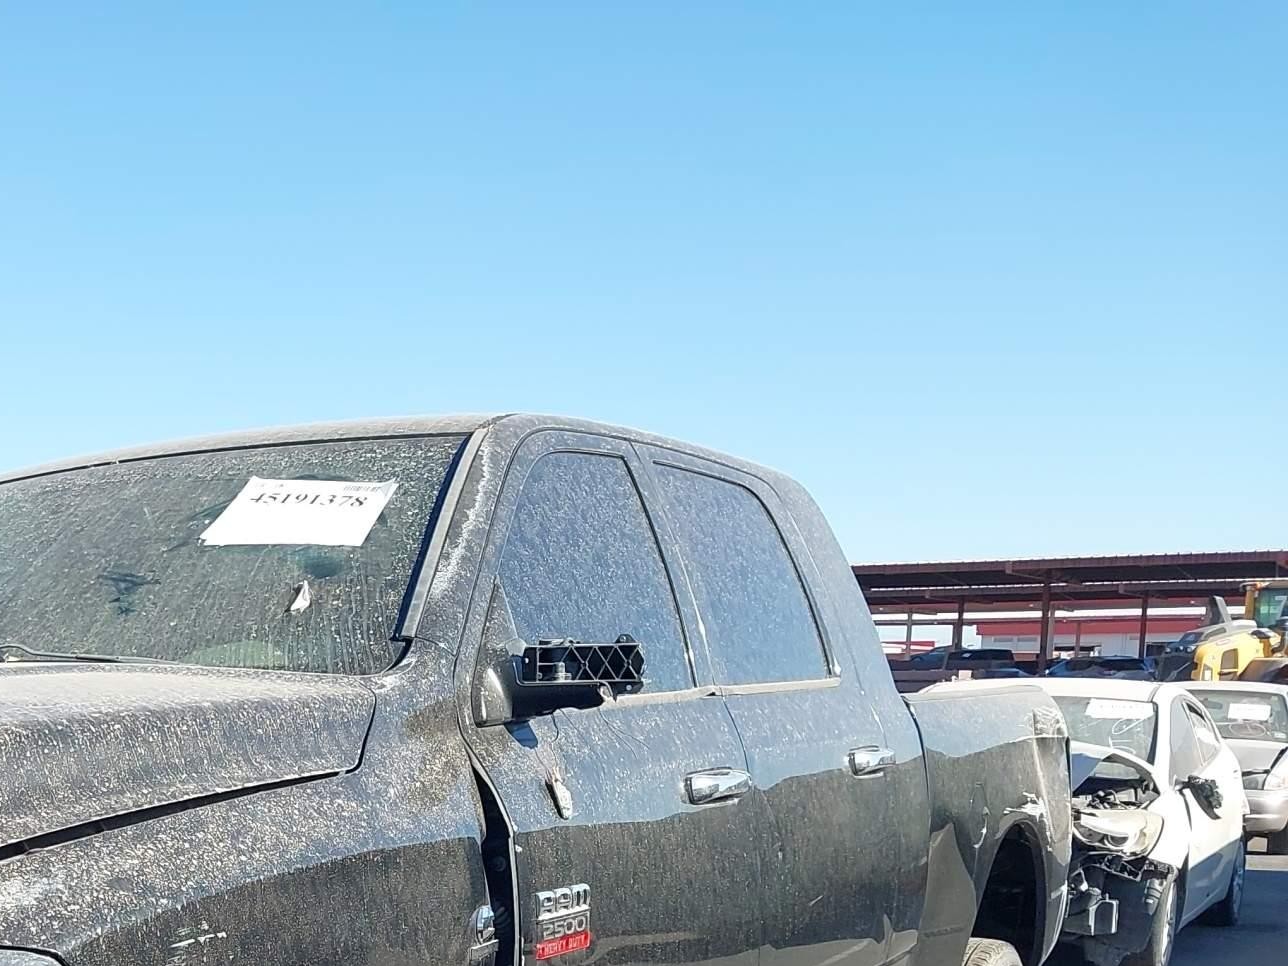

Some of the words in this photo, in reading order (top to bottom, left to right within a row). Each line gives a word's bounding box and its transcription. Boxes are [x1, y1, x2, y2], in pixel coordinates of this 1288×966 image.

[250, 492, 368, 507] 45191378
[536, 883, 591, 917] RAM
[543, 915, 586, 940] 2500
[543, 939, 567, 956] HEAVY
[568, 934, 586, 950] DUTY
